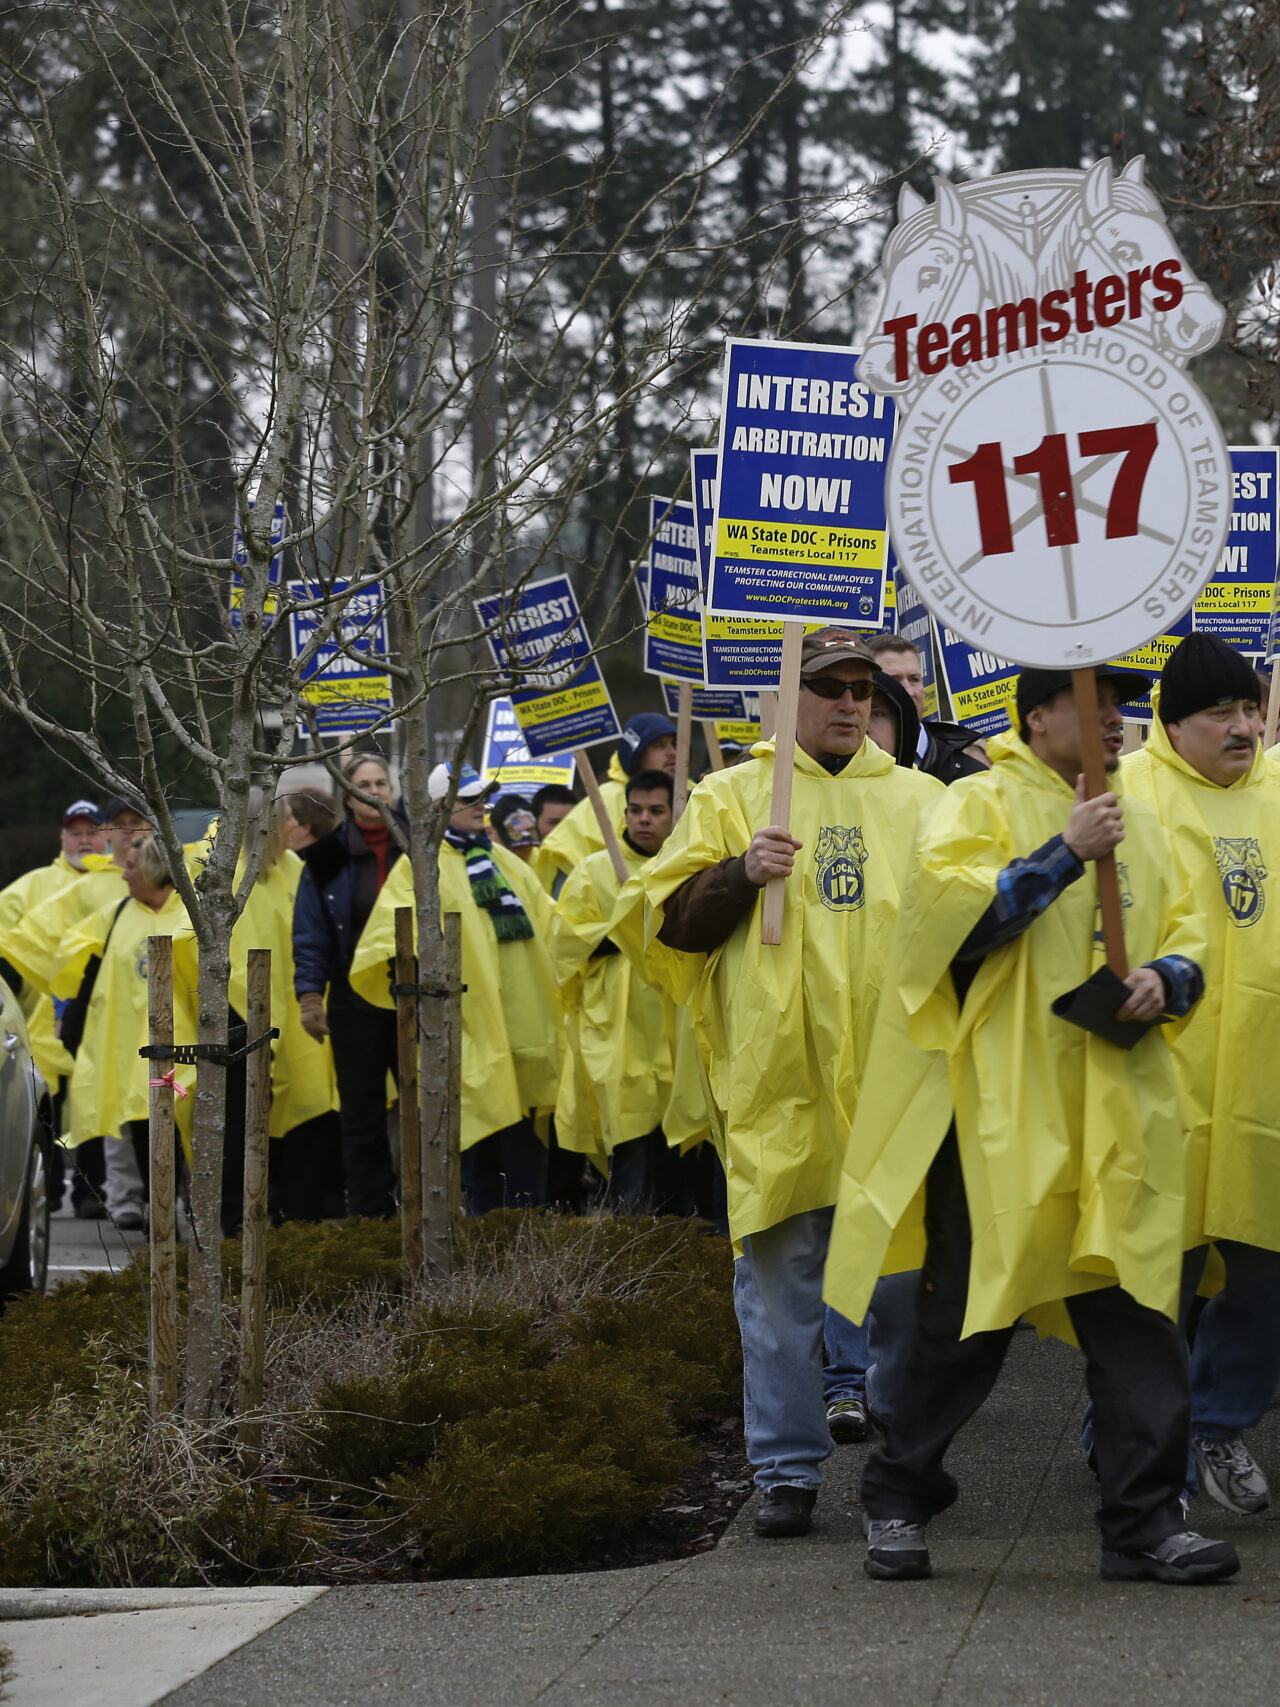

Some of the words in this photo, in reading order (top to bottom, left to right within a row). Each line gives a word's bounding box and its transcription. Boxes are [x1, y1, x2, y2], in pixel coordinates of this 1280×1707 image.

[883, 259, 1184, 382] Teamsters
[737, 373, 887, 419] INTEREST
[1168, 392, 1203, 429] OF
[731, 426, 885, 462] ARBITRATION
[759, 472, 852, 514] NOW!
[948, 422, 1158, 557] 117
[655, 518, 696, 549] INTER
[900, 409, 994, 635] INTERNATIONAL
[1143, 435, 1219, 622] TEAMSTERS
[727, 525, 749, 540] WA
[751, 527, 788, 543] State
[790, 529, 818, 545] DOC
[828, 532, 877, 550] Prisons
[654, 552, 698, 577] ARBITRA
[750, 544, 805, 558] Teamsters
[807, 548, 836, 560] Local
[838, 551, 857, 561] 117
[723, 566, 766, 577] TEAMSTER
[766, 568, 827, 581] CORRECTIONAL
[827, 574, 875, 584] EMPLOYEES
[734, 577, 785, 589] PROTECTING
[785, 581, 805, 590] OUR
[805, 582, 862, 594] COMMUNITIES
[666, 583, 701, 613] NOW
[745, 593, 850, 610] www.DOCProtectsWA.org
[1205, 587, 1225, 598] DOC
[1234, 587, 1271, 598] Prisons
[727, 626, 766, 634] Teamsters
[1136, 653, 1157, 665] Local
[1160, 657, 1168, 665] 11
[1151, 640, 1177, 654] Priso
[968, 651, 1016, 678] NOW
[958, 695, 972, 705] WA
[973, 688, 994, 701] State
[996, 682, 1012, 694] DOC
[976, 698, 1005, 711] Teamster
[974, 722, 1003, 734] ROTECTING
[990, 712, 1008, 723] CORREC
[831, 863, 856, 876] LOCAL
[831, 875, 858, 900] 117
